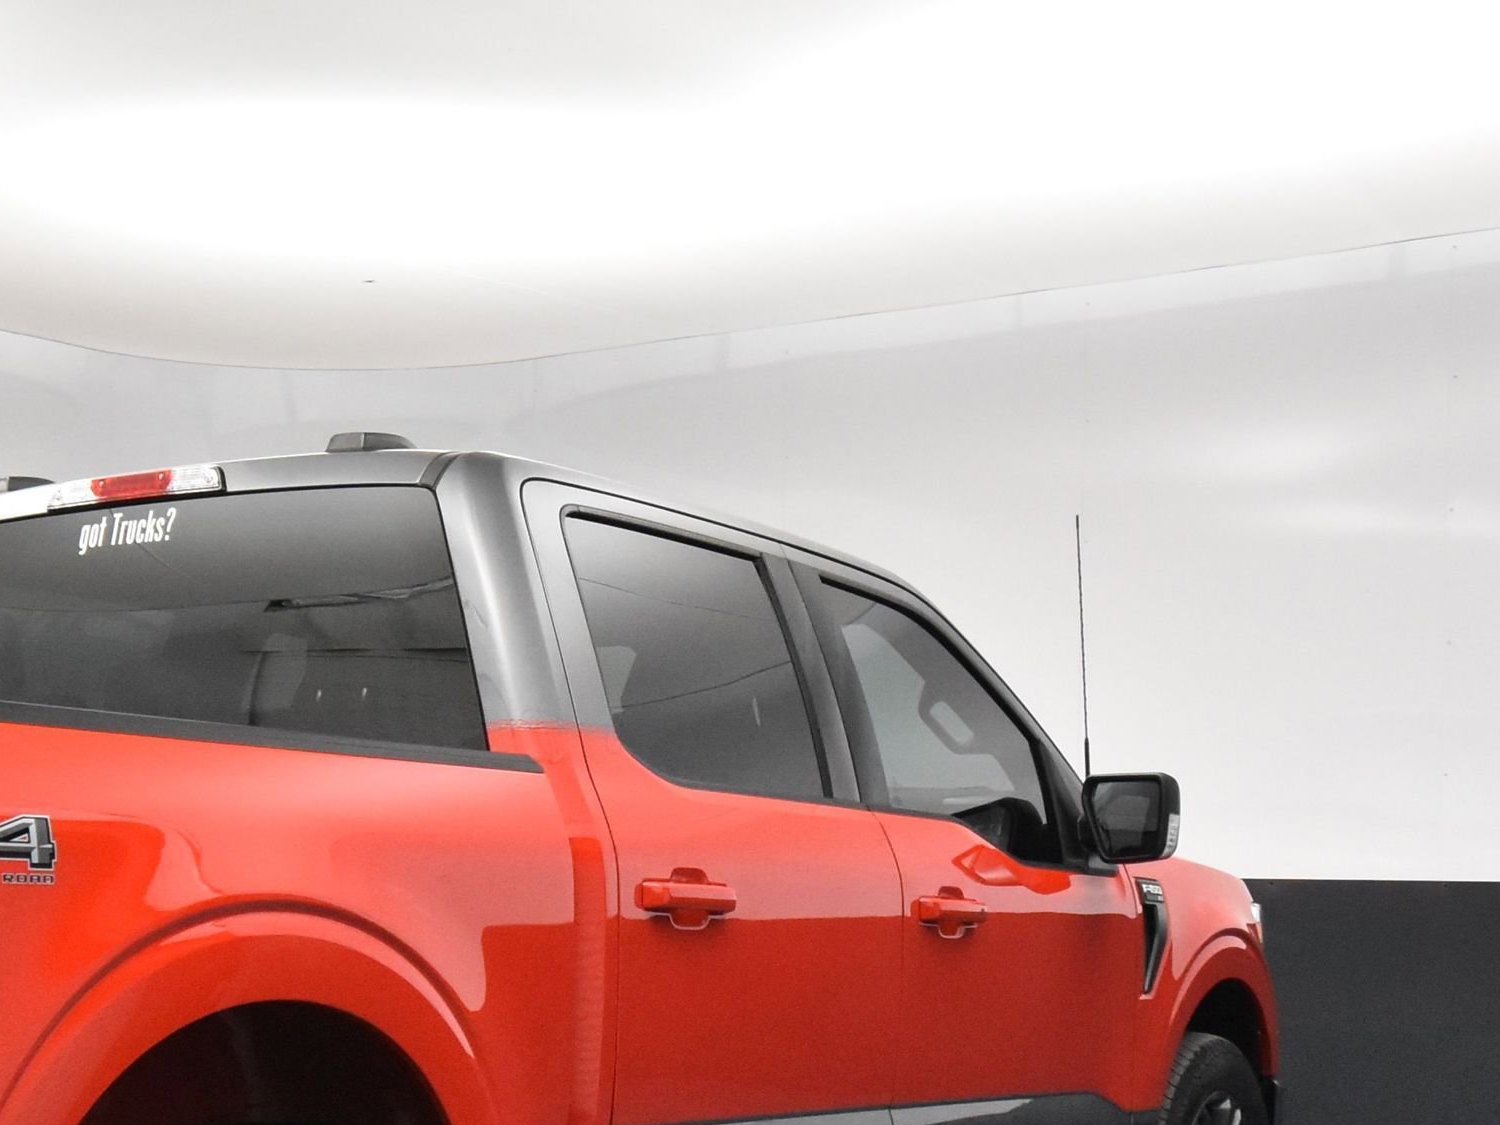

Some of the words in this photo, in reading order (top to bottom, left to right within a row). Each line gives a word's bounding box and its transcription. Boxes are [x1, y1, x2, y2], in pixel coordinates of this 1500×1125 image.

[78, 516, 107, 556] got
[110, 507, 177, 546] Trucks?
[2, 873, 55, 884] ROAD
